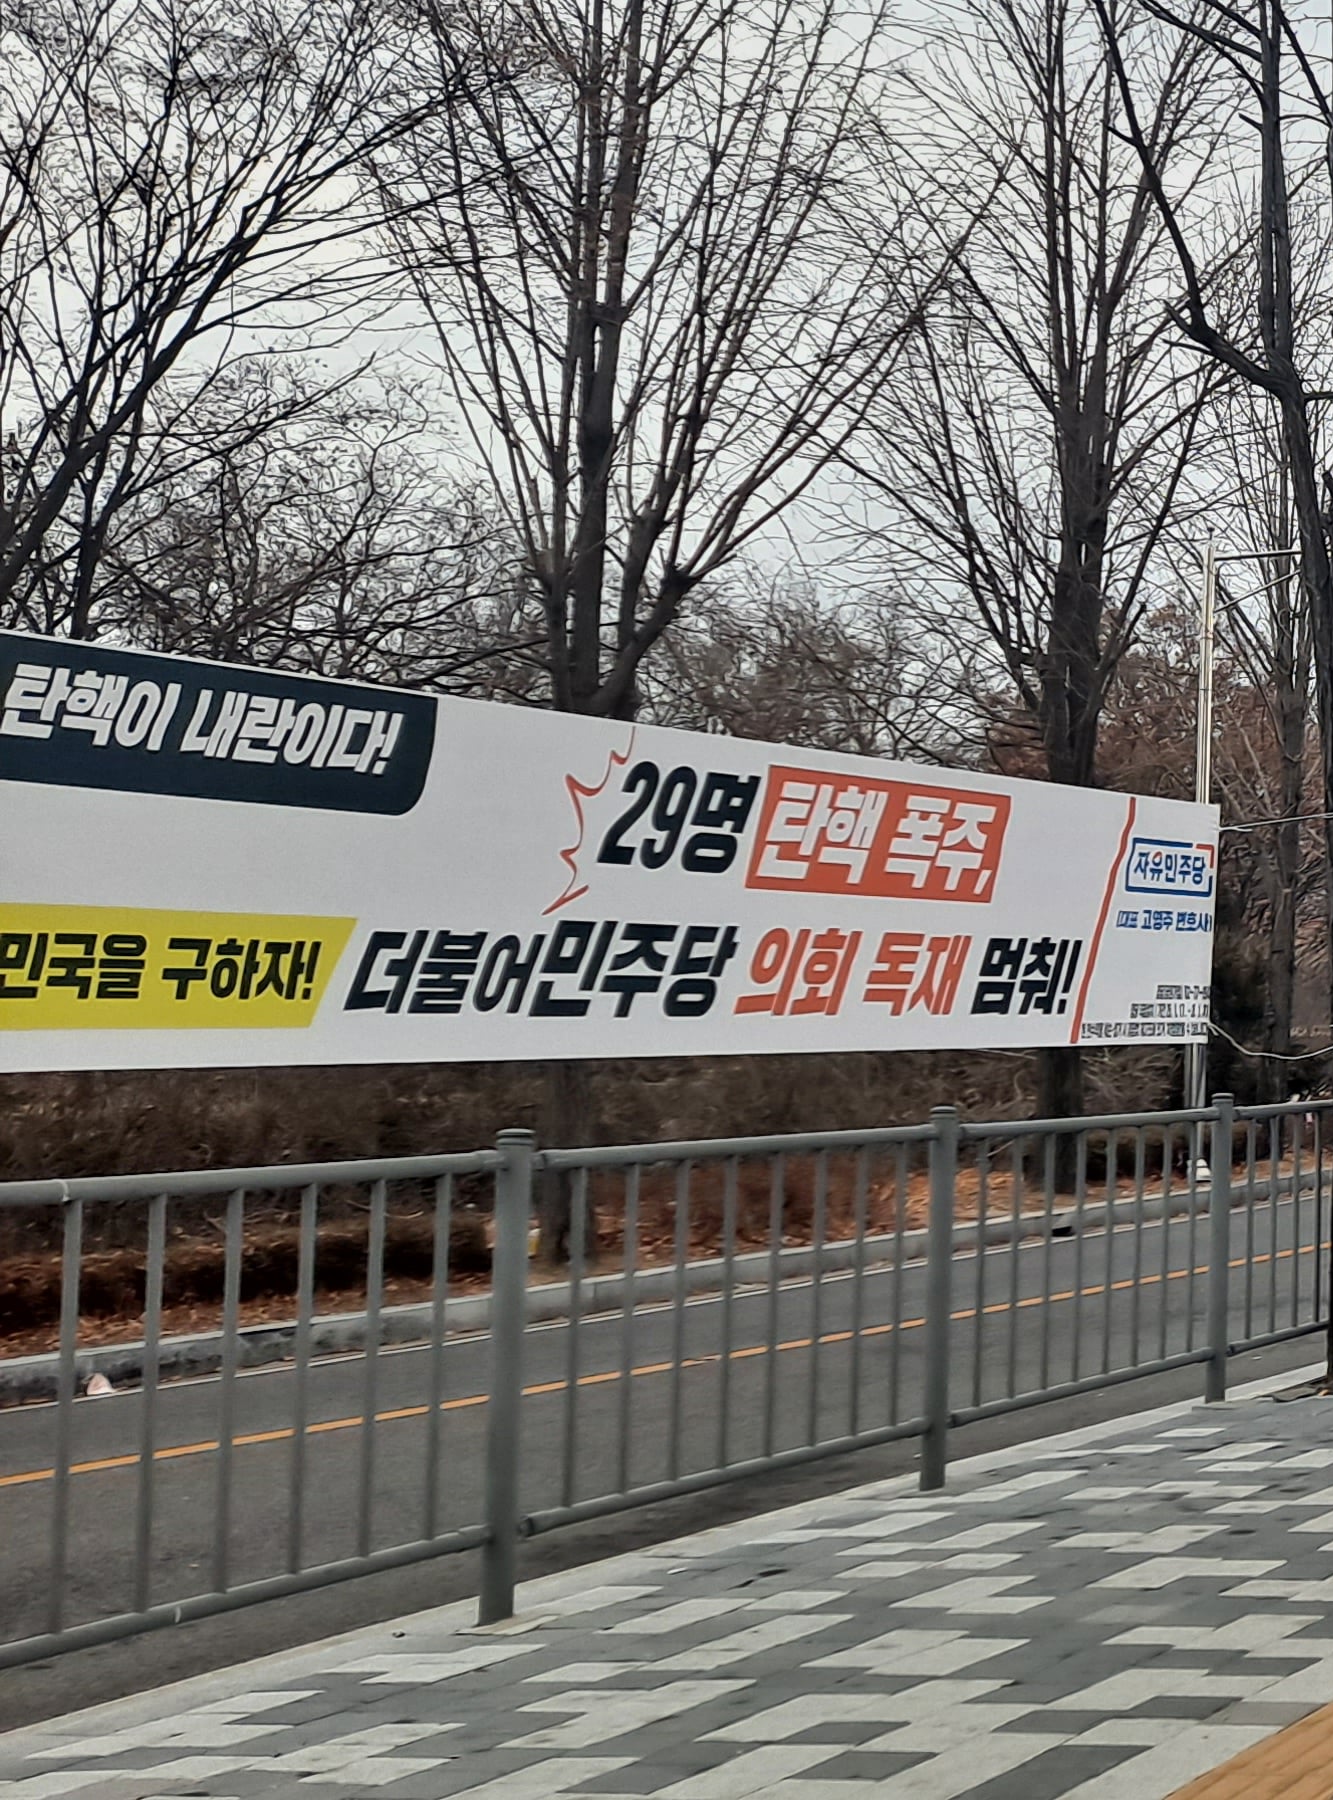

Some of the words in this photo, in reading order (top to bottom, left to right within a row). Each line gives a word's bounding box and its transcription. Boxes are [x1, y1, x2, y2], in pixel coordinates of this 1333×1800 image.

[0, 662, 183, 752] 탄핵이
[180, 690, 405, 775] 내란이다!
[597, 760, 762, 874] 29명
[756, 783, 888, 886] 탄핵
[886, 795, 998, 895] 폭주,
[1133, 850, 1206, 885] 자유민주당
[161, 937, 321, 1000] 구하자!
[343, 919, 738, 1019] 더불어민주당
[733, 928, 863, 1017] 의회
[865, 931, 972, 1016] 독재
[970, 937, 1083, 1016] 멈춰!
